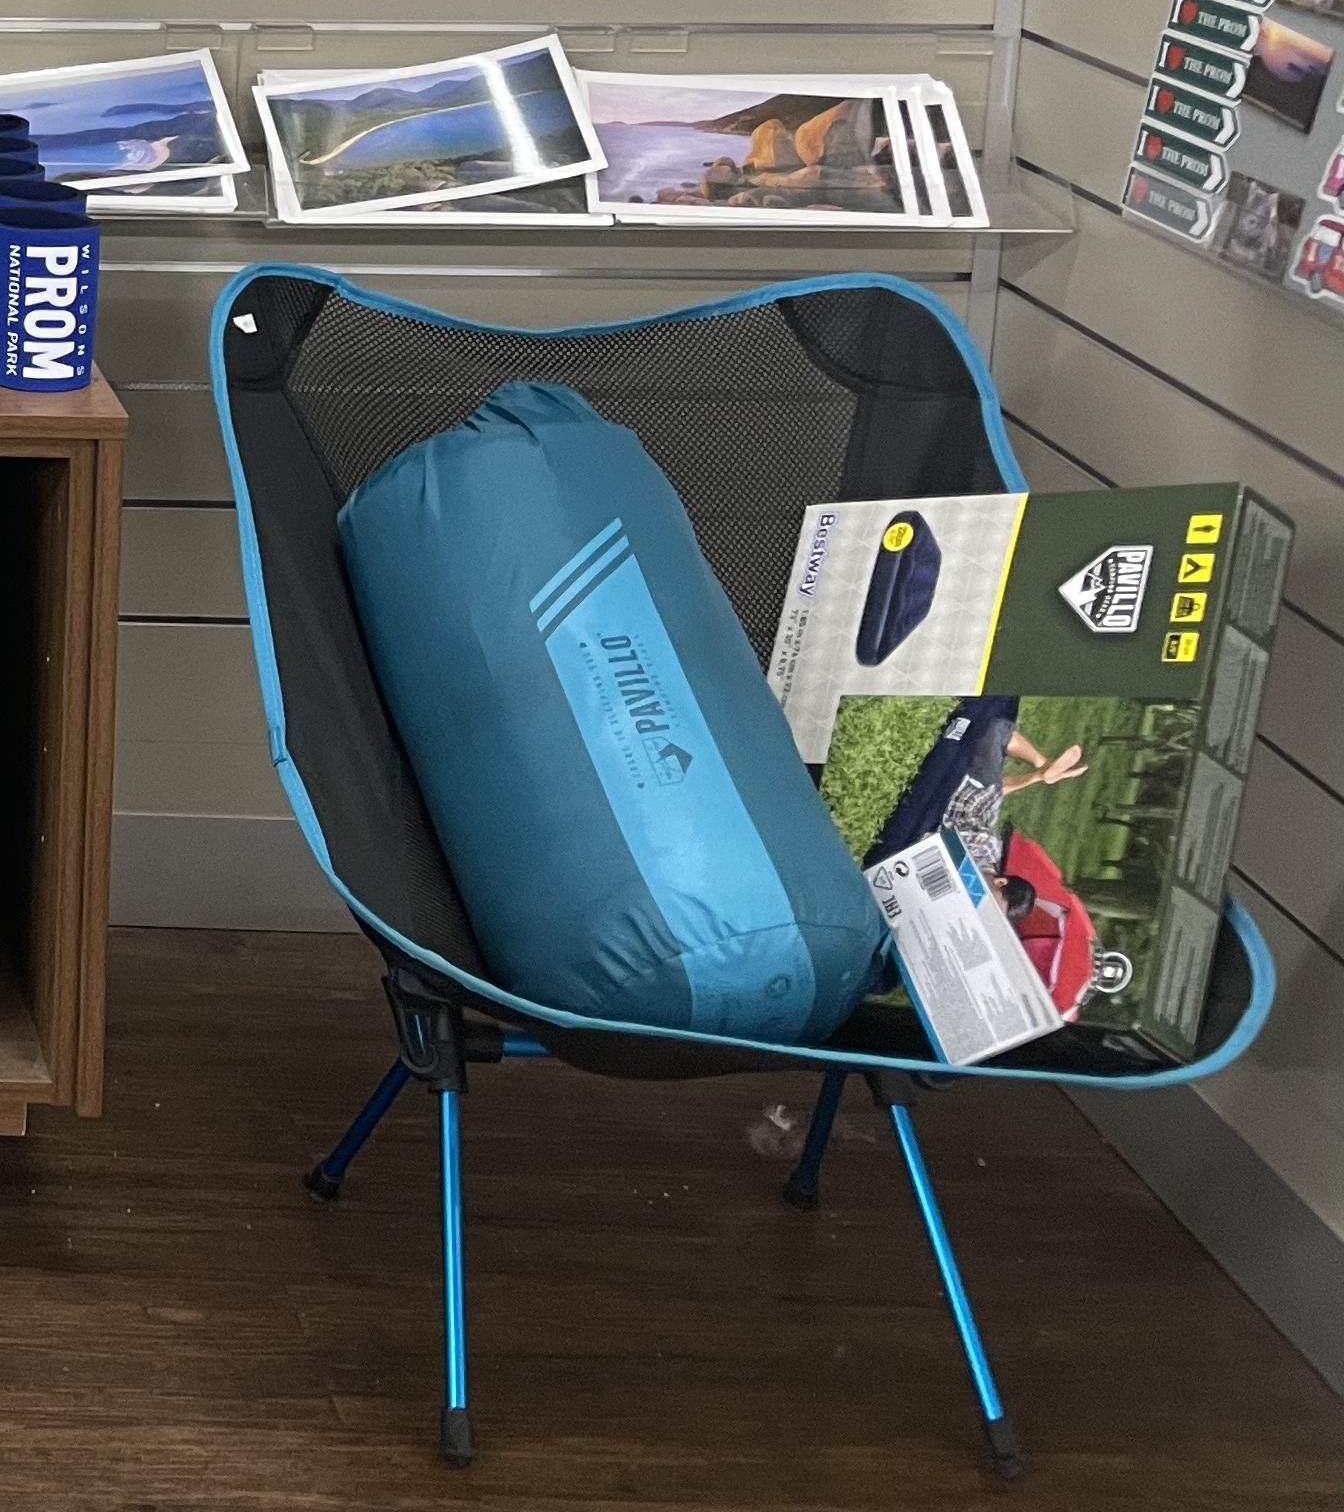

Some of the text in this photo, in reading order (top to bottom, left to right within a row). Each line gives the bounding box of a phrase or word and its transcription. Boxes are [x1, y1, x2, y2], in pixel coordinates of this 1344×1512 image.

[6, 244, 22, 376] NATIONAL PARK
[23, 245, 79, 380] PROM
[76, 244, 91, 376] WILSONS
[800, 514, 836, 597] Bestway
[1103, 552, 1146, 627] PAVILLO
[600, 635, 670, 734] PAVILLO
